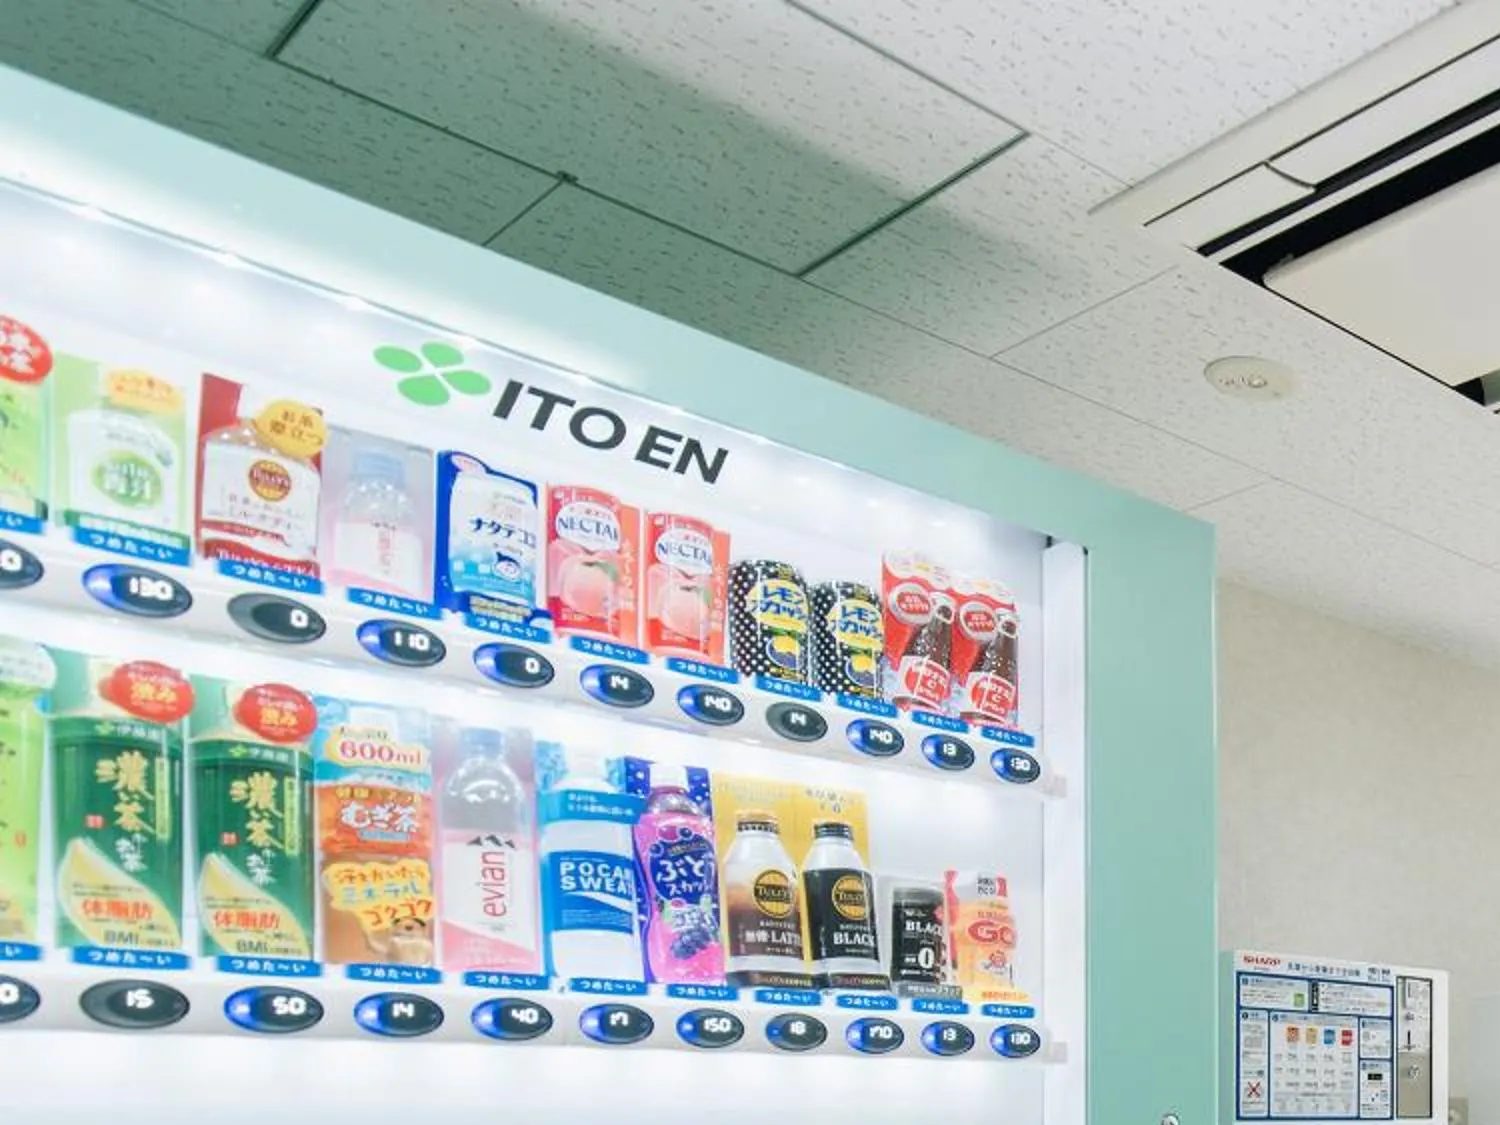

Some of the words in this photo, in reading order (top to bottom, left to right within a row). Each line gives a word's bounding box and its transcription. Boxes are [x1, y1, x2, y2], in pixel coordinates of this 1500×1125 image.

[493, 379, 627, 450] ITO
[634, 425, 729, 484] EN
[341, 801, 420, 833] むぎ茶
[475, 851, 506, 918] evian
